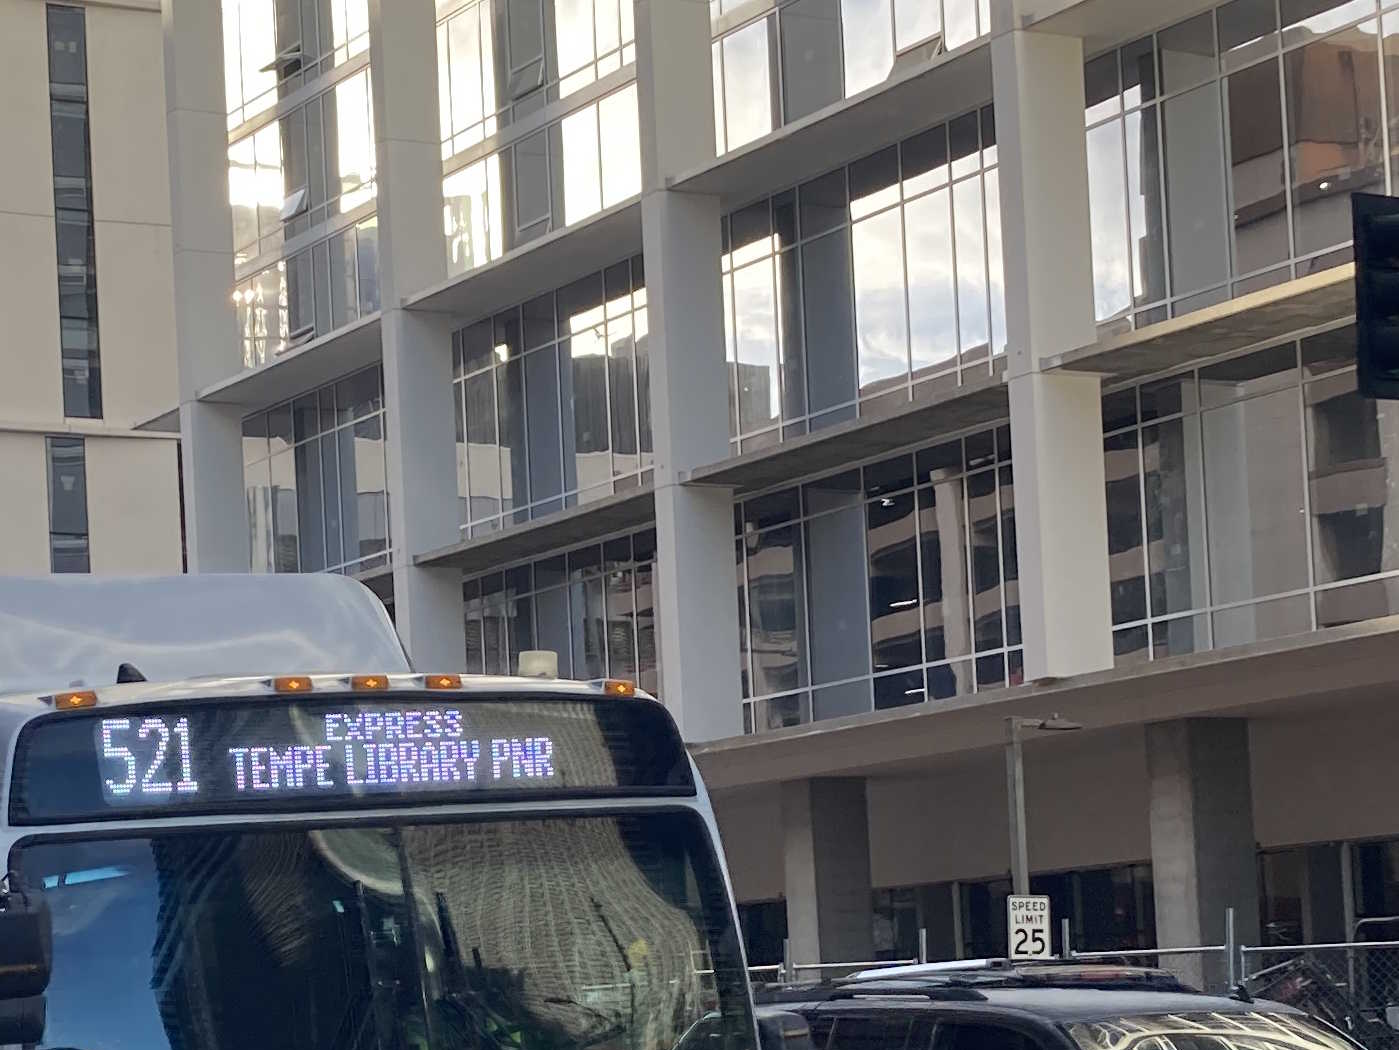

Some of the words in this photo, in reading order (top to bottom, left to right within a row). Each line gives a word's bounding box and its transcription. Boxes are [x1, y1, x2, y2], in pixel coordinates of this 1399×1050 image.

[324, 710, 464, 741] EXPRESS
[102, 717, 198, 794] 521
[229, 744, 334, 790] TEMPE
[344, 739, 480, 785] LIBRARY
[491, 736, 555, 780] PNR
[1011, 901, 1046, 912] SPEED
[1015, 914, 1044, 925] LIMIT
[1014, 928, 1046, 955] 25
